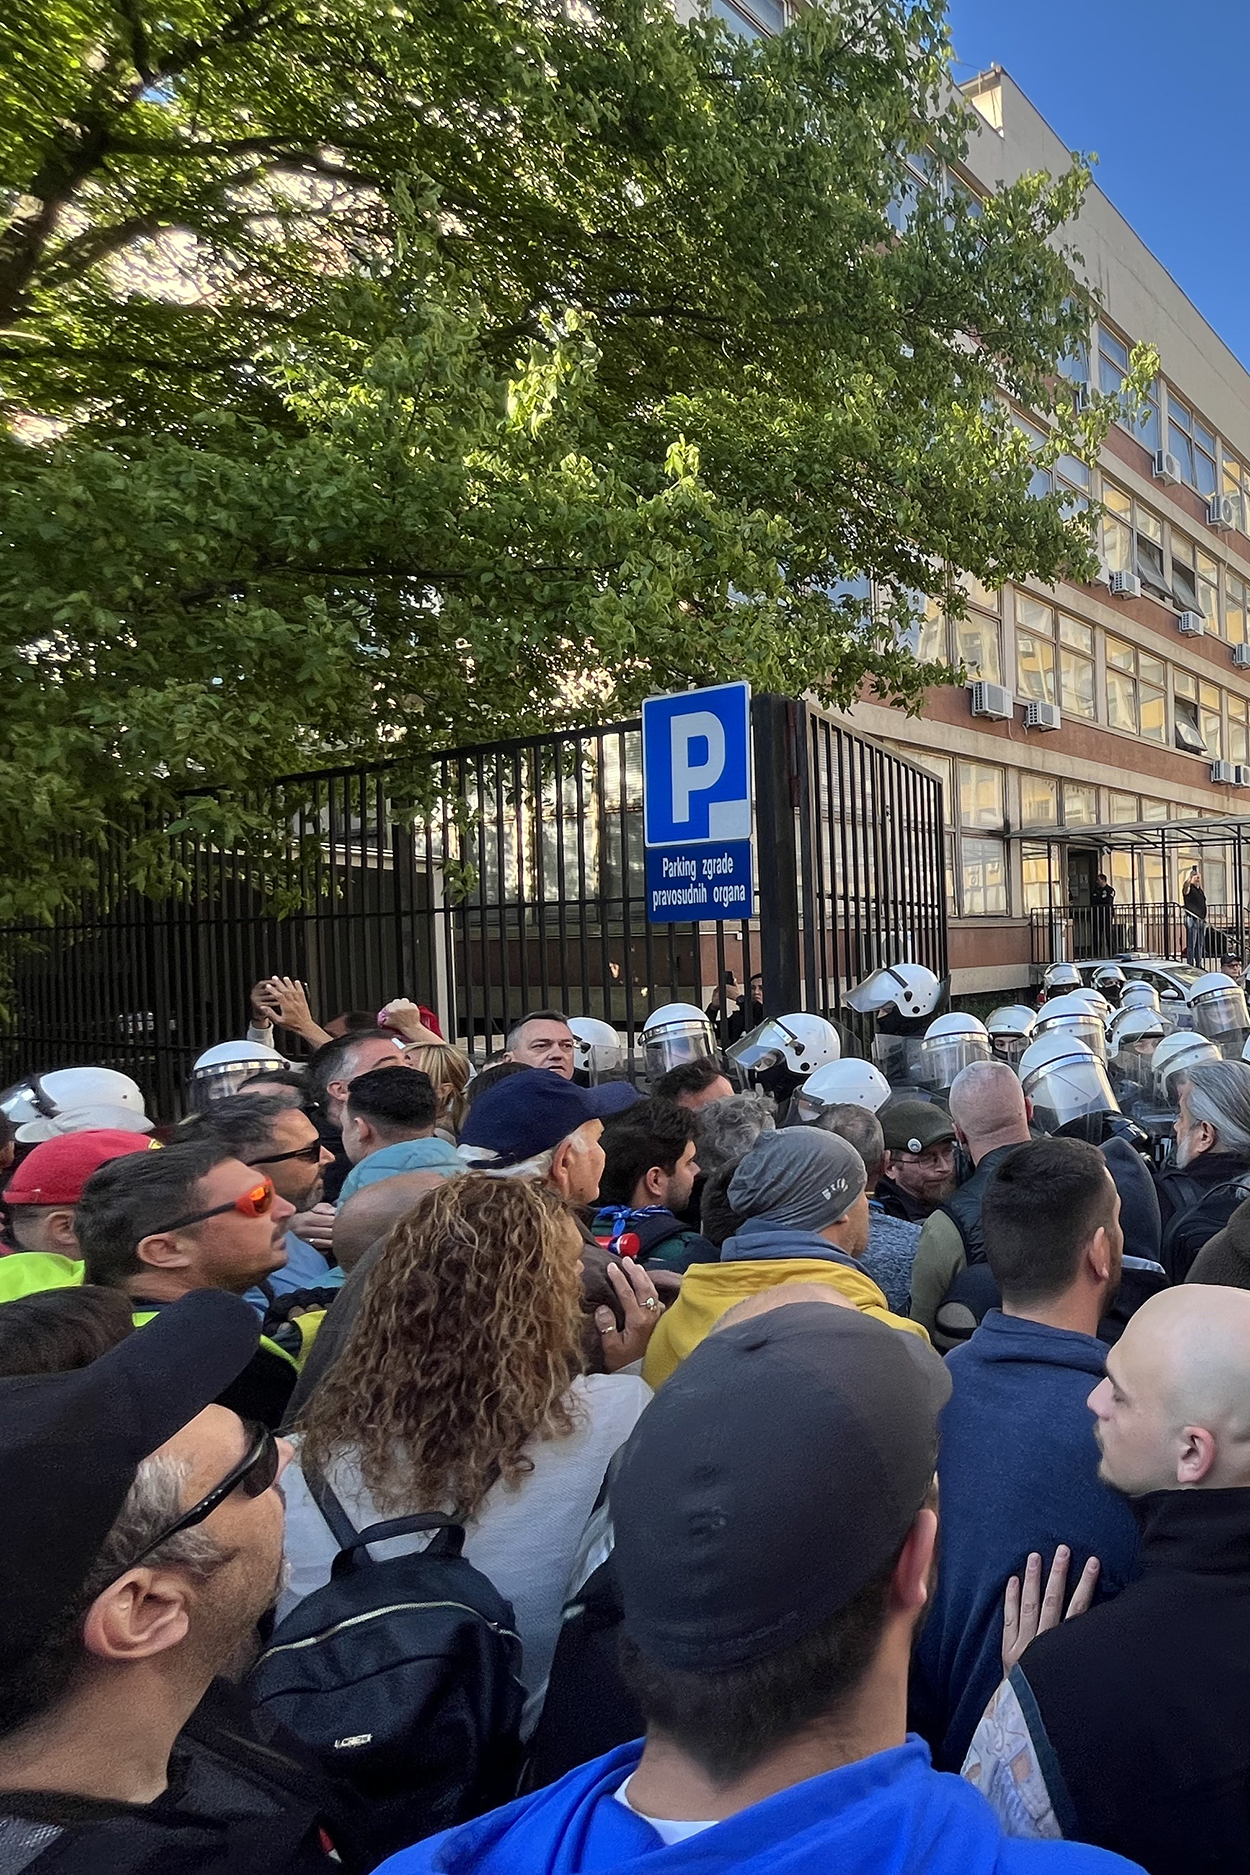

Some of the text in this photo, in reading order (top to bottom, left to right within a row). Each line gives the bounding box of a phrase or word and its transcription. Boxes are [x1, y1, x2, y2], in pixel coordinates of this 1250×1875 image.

[670, 710, 726, 824] P
[662, 852, 734, 881] Parking zgrade
[652, 882, 746, 912] pravosudnih organa
